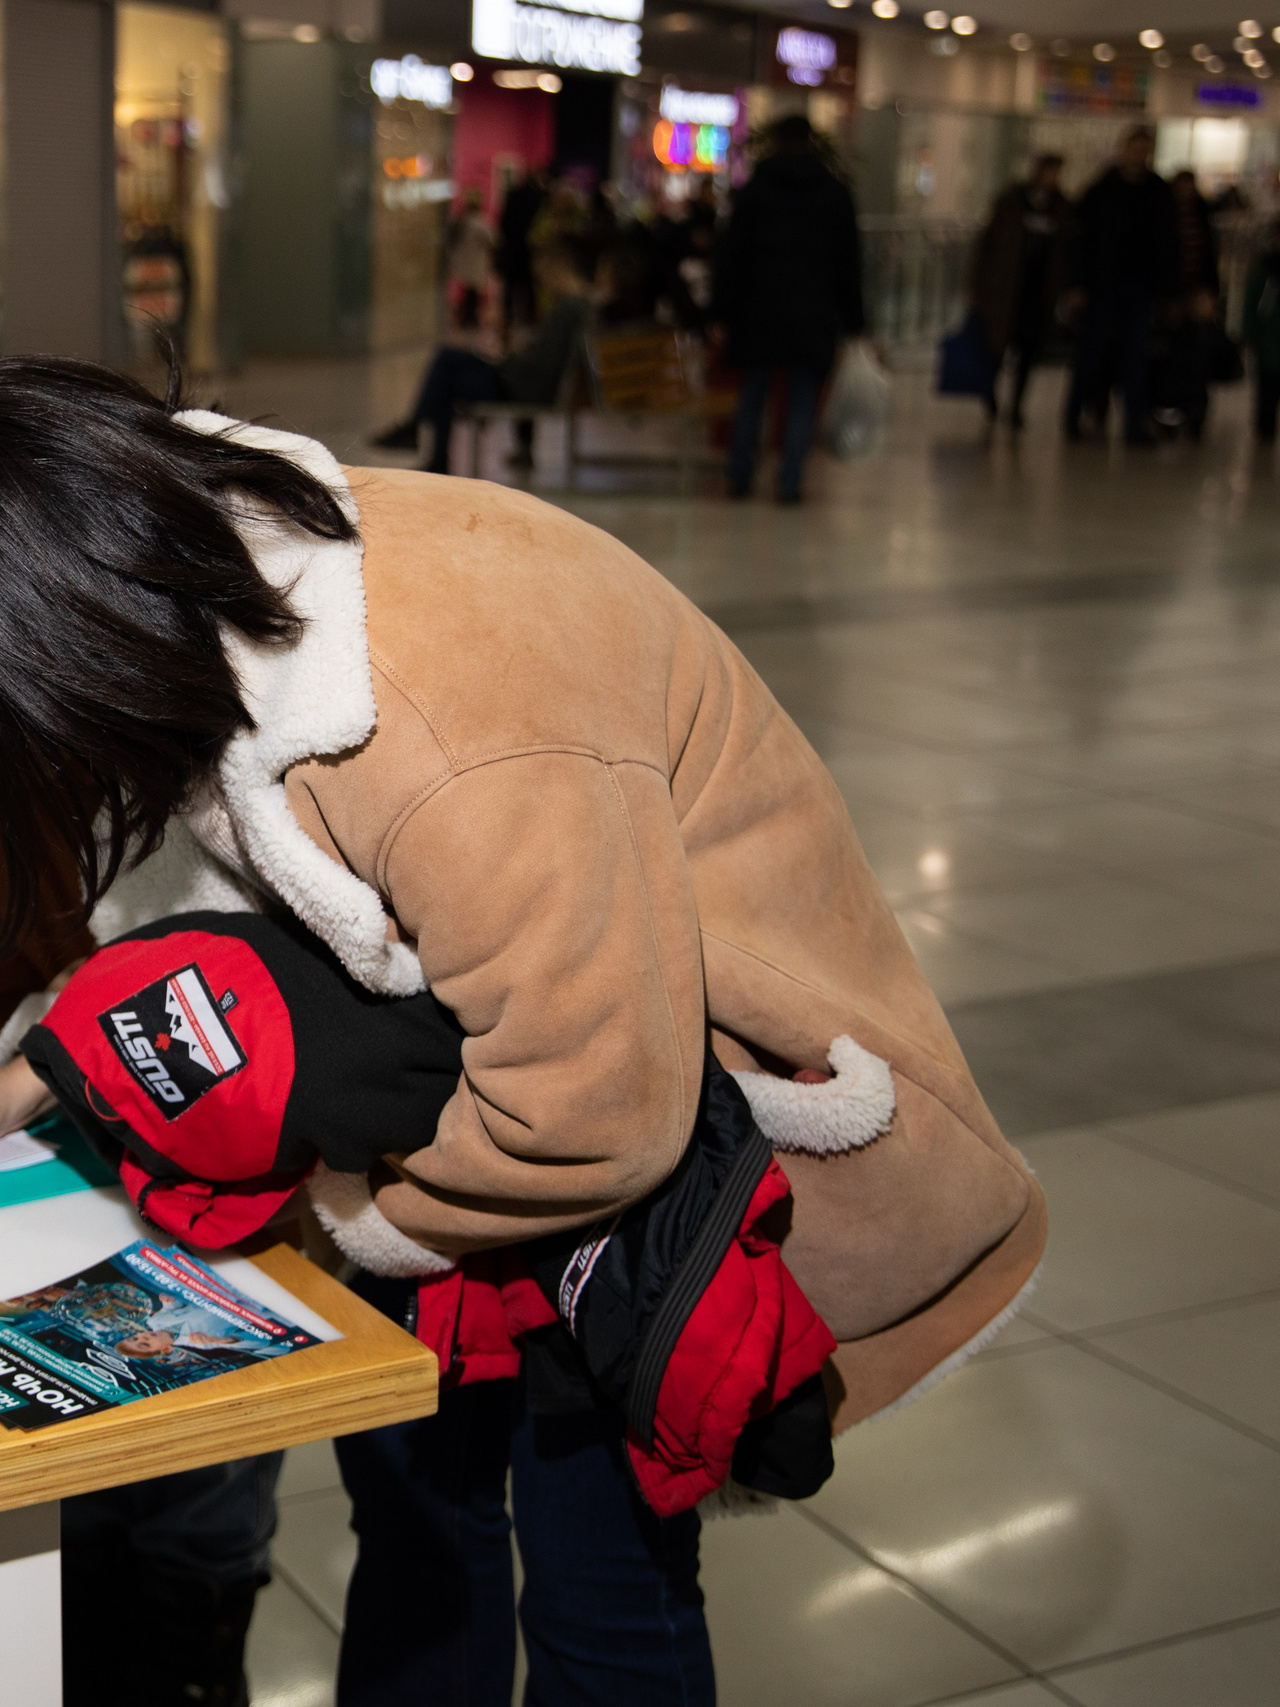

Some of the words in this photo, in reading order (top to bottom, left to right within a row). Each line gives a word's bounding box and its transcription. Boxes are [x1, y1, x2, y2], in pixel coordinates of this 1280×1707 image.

[108, 1009, 185, 1103] GUSTI
[123, 1251, 154, 1275] 15:00
[153, 1271, 178, 1291] 7.02
[11, 1369, 85, 1415] НОЧЬ
